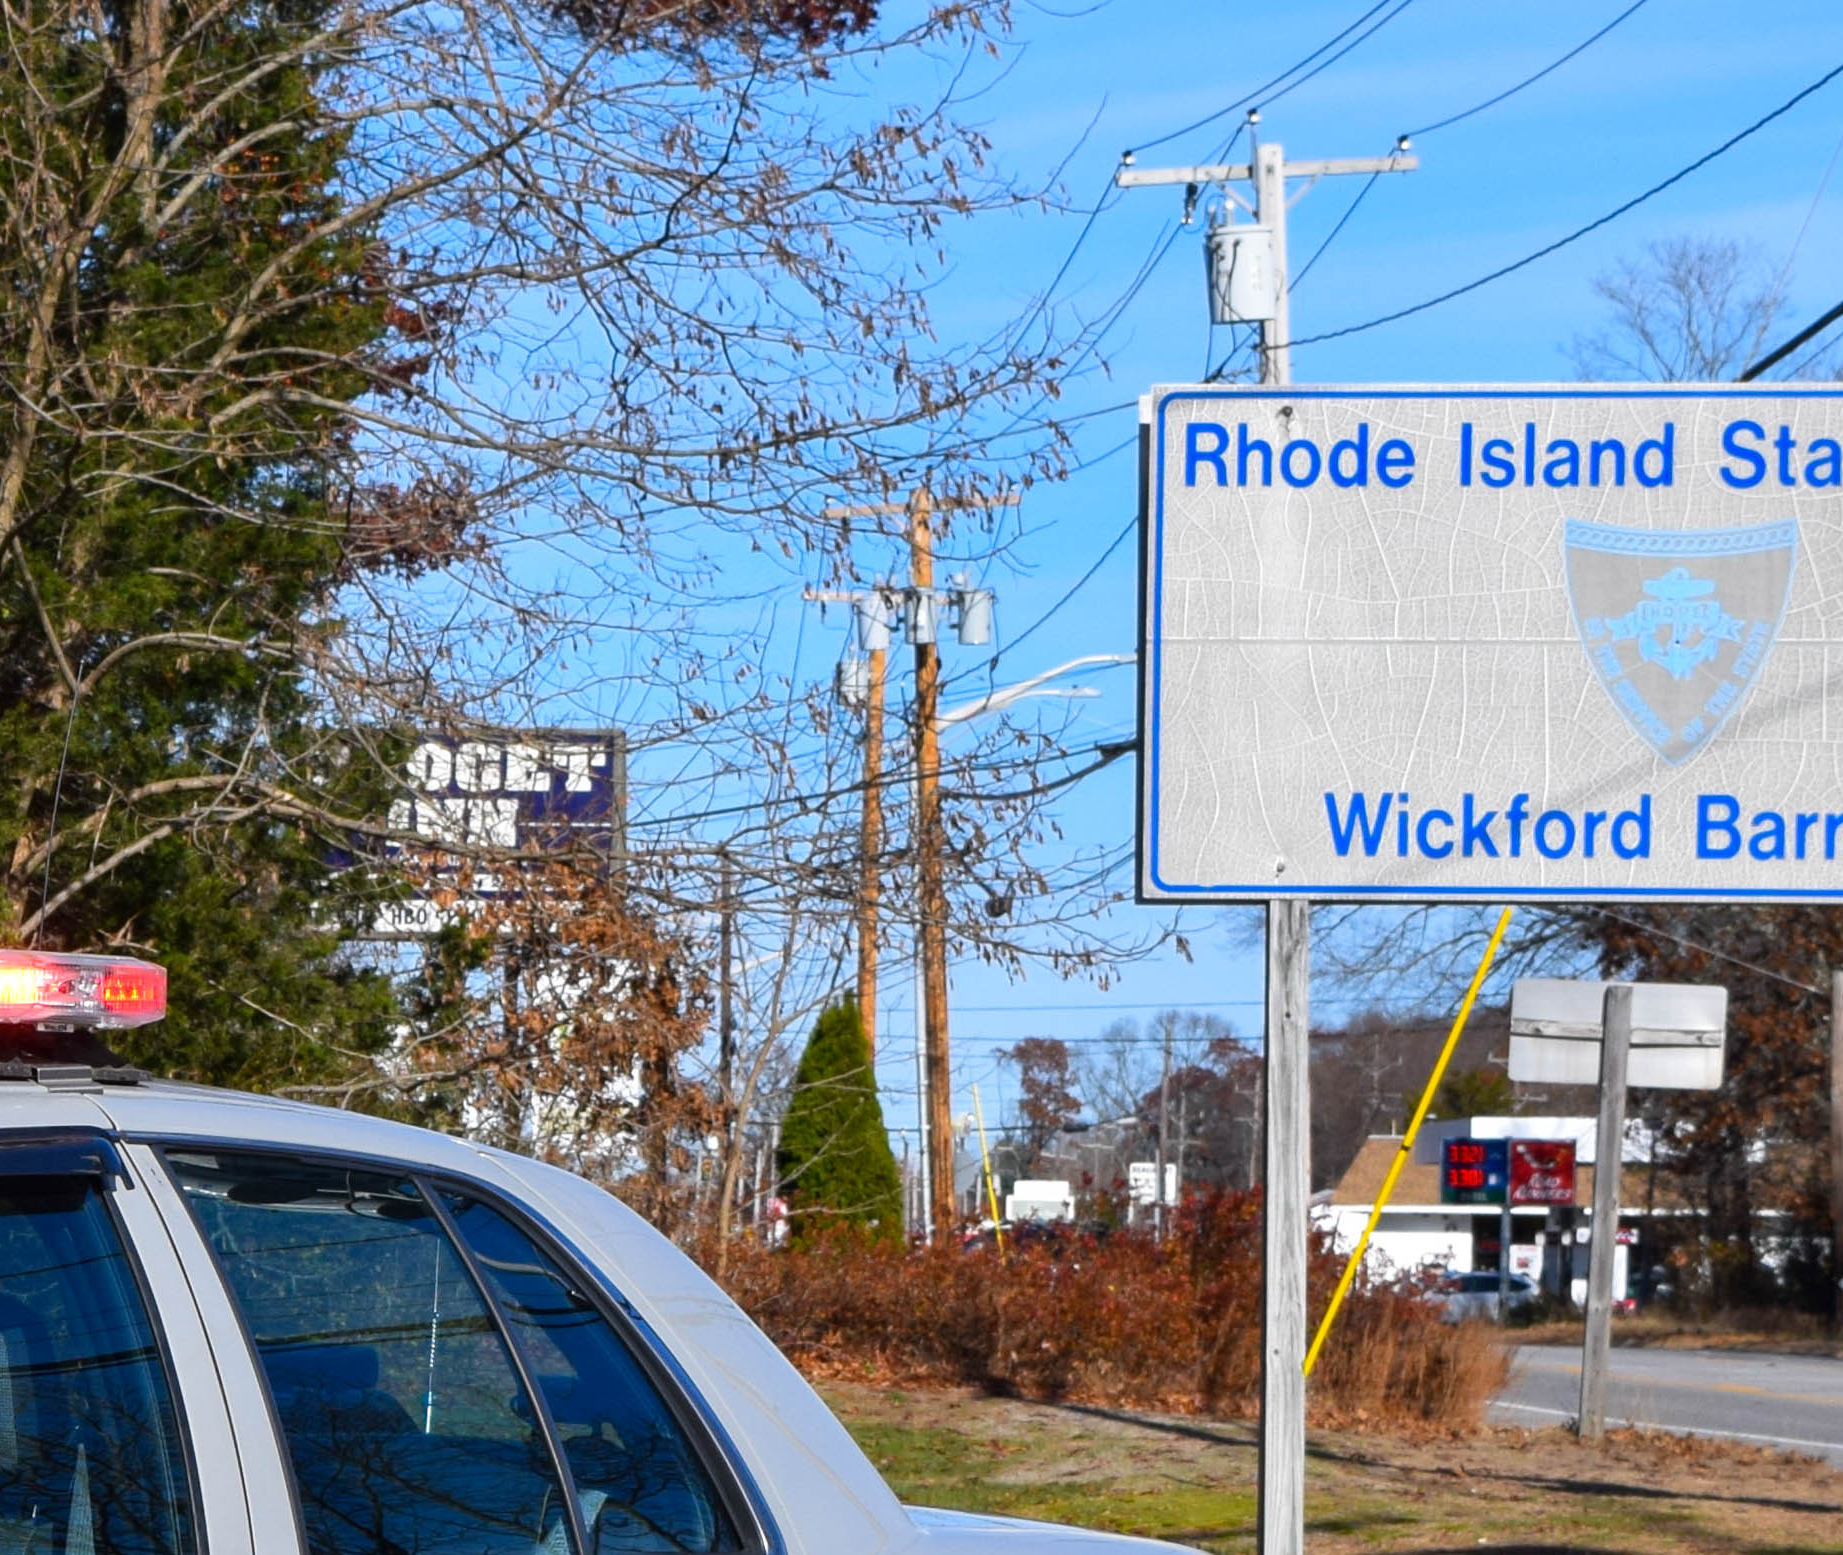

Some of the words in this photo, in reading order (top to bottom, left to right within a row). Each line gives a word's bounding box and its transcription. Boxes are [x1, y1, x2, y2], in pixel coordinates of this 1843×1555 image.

[1185, 422, 1416, 488] Rhode
[1460, 422, 1675, 488] Island
[1719, 420, 1843, 488] Sta
[1324, 792, 1652, 860] Wickford
[1695, 794, 1843, 861] Barr
